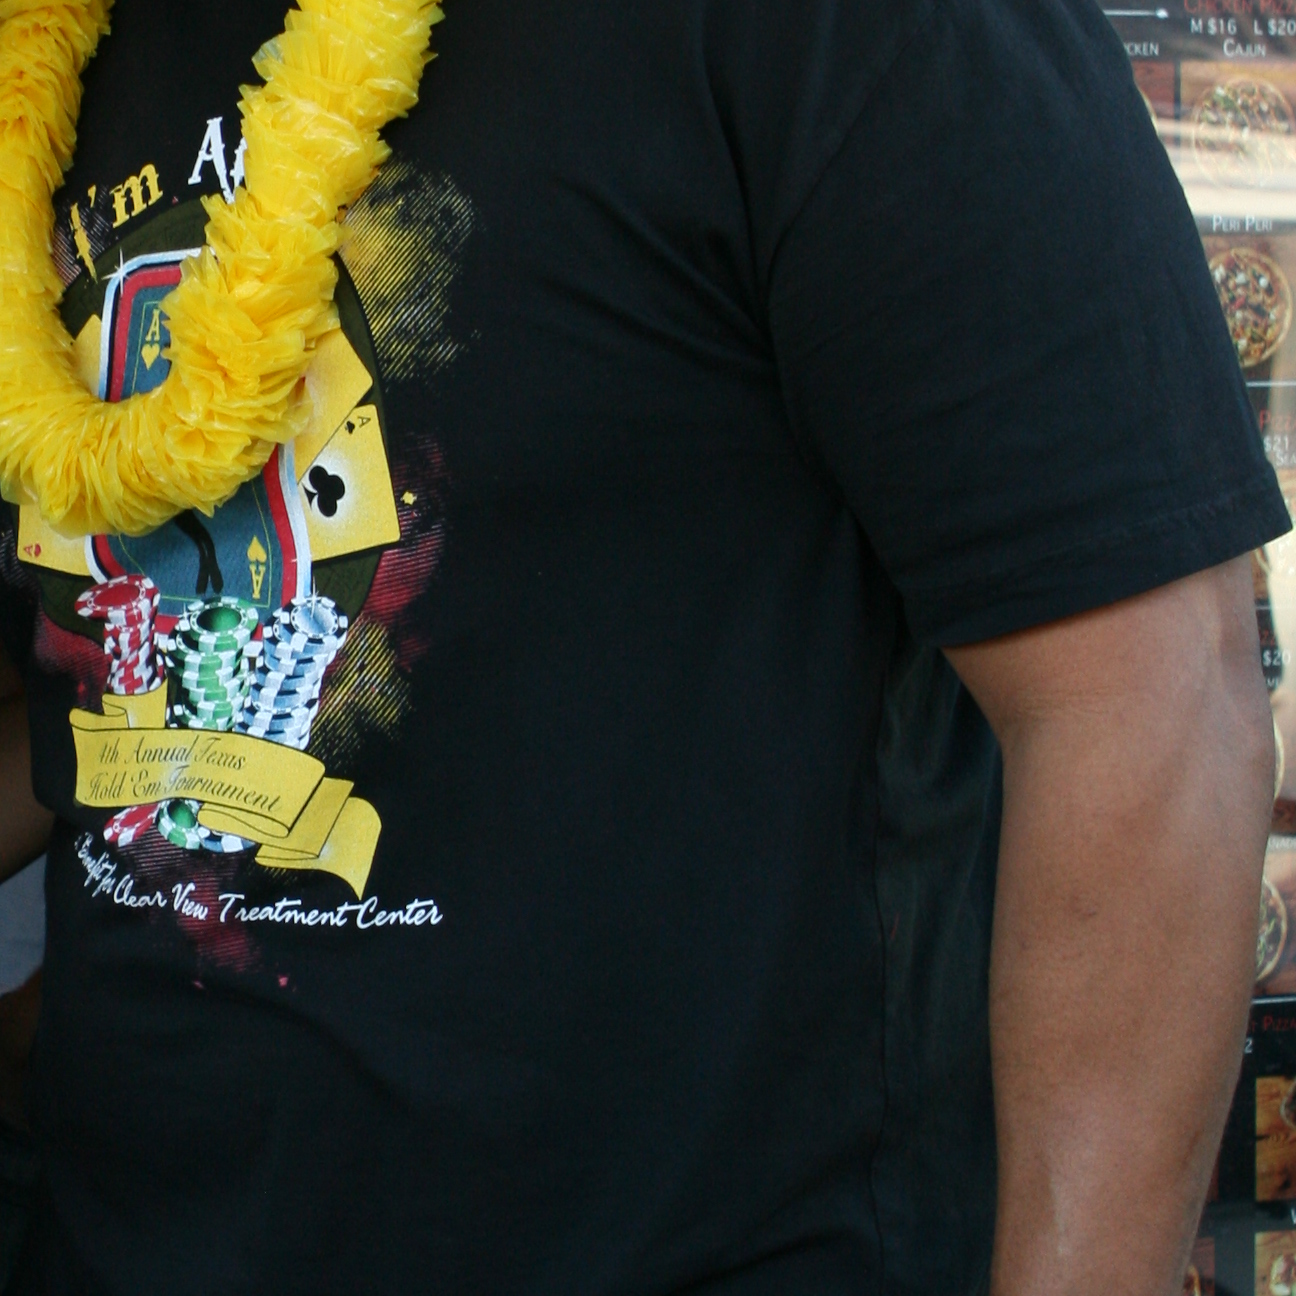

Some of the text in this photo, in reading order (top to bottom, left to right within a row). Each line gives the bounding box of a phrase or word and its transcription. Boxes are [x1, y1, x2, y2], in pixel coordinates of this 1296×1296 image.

[1189, 17, 1203, 34] M
[1206, 17, 1237, 36] $16
[1252, 19, 1263, 36] L
[1222, 37, 1266, 58] CAJUN
[1262, 649, 1291, 668] $20
[124, 733, 201, 766] Annual
[193, 735, 247, 772] Texas
[84, 770, 129, 802] Hold
[162, 764, 285, 813] Tournament
[112, 871, 169, 910] Clear
[171, 881, 210, 921] View
[218, 892, 362, 928] Treatment
[355, 894, 444, 930] Center
